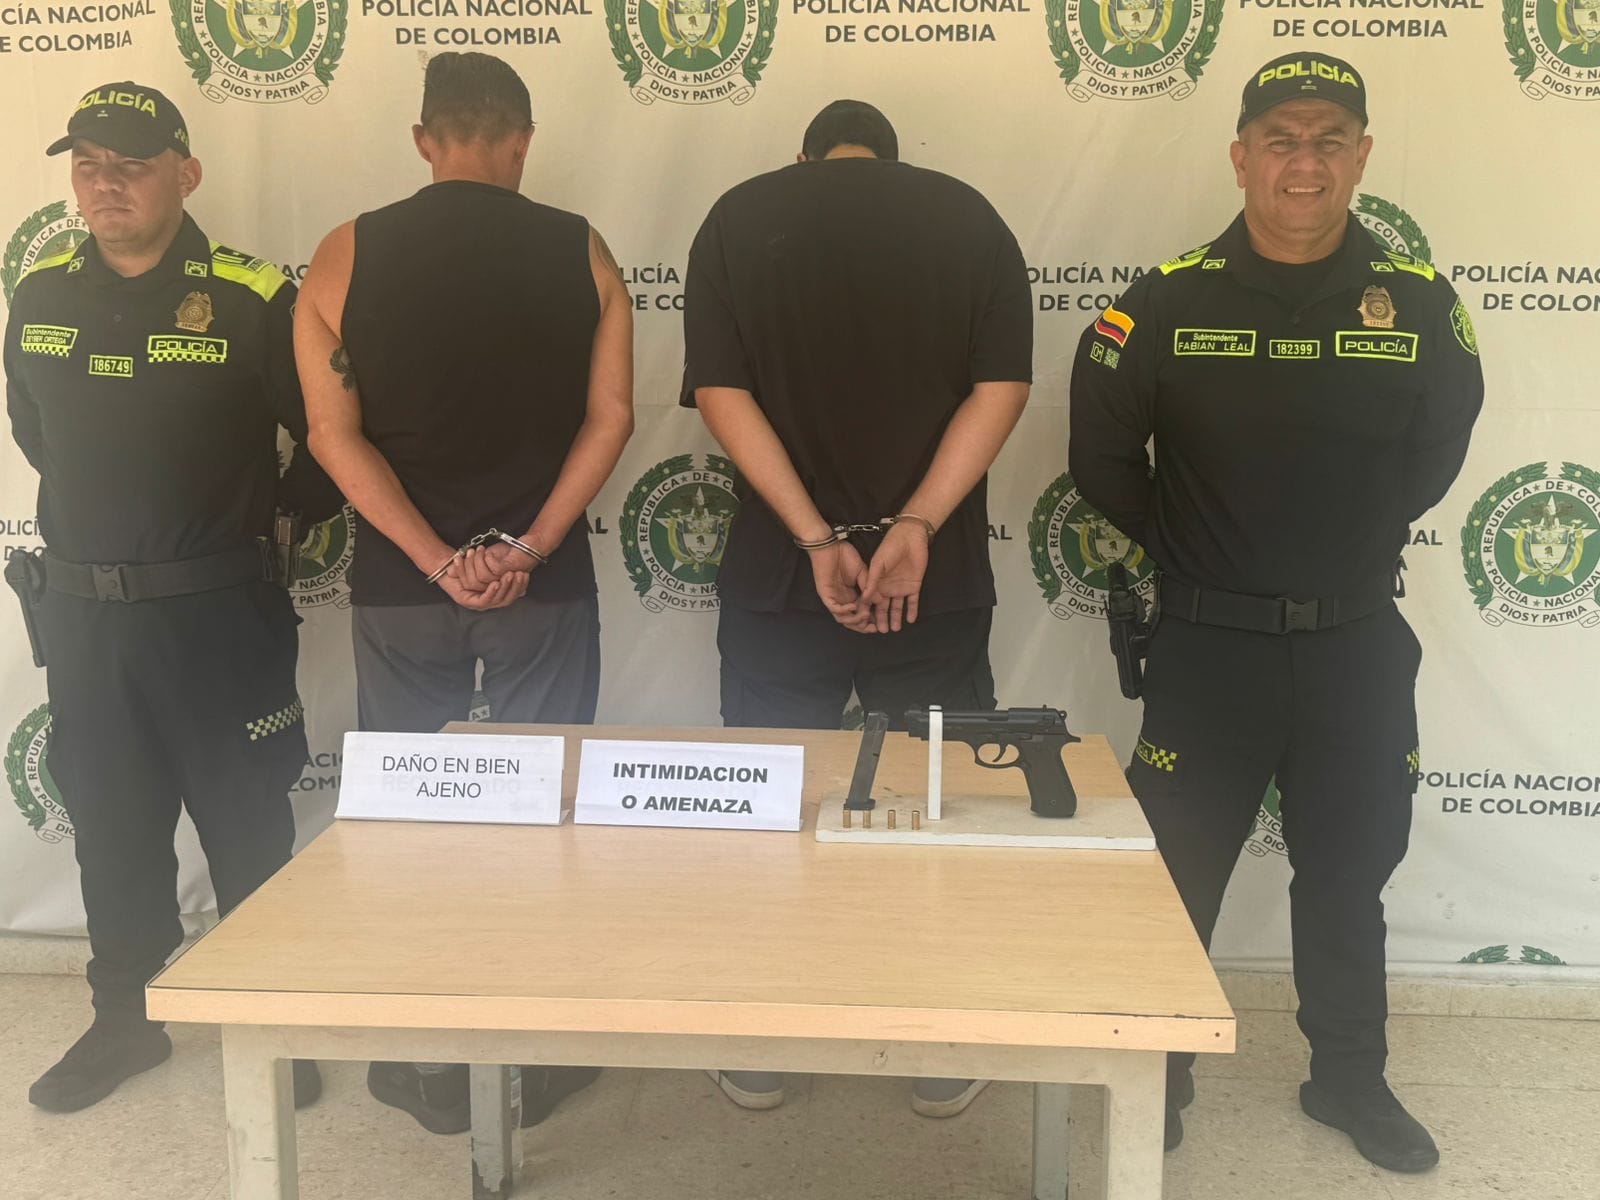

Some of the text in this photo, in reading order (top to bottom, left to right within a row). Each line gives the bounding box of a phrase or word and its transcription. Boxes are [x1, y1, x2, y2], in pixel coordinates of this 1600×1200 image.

[47, 0, 156, 24] NACIONAL
[466, 0, 593, 16] NACIONAL
[898, 0, 1030, 13] NACIONAL
[395, 26, 561, 45] DE COLOMBIA
[825, 24, 996, 43] DE COLOMBIA
[1273, 19, 1448, 37] DE COLOMBIA
[18, 30, 133, 52] COLOMBIA
[265, 40, 322, 83] NACIONAL
[693, 41, 751, 84] NACIONAL
[1133, 36, 1197, 80] NACIONAL
[266, 80, 310, 100] PATRIA
[693, 81, 737, 101] PATRIA
[1132, 75, 1178, 96] PATRIA
[22, 218, 81, 274] UBLICA DE
[1374, 222, 1407, 254] COLO
[618, 262, 680, 284] LICÍA
[1026, 262, 1104, 284] OLICÍA
[1451, 261, 1549, 284] POLICÍA
[1039, 294, 1070, 311] DE
[1483, 293, 1514, 311] DE
[155, 340, 218, 354] POLICÍA
[1178, 341, 1251, 352] FABIAN LEAL
[1276, 343, 1313, 355] 182399
[1344, 338, 1409, 354] POLICÍA
[94, 359, 130, 373] 186749
[693, 472, 710, 482] DE
[1546, 480, 1564, 491] DE
[300, 553, 352, 590] NACIONAL
[300, 587, 340, 605] PATRIA
[700, 599, 719, 608] PAT
[1542, 605, 1587, 623] PATRIA
[382, 753, 521, 775] DAÑO EN BIEN
[613, 762, 769, 784] INTIMIDACION
[416, 781, 482, 799] AJENO
[38, 793, 70, 820] POLIC
[621, 794, 753, 814] O AMENAZA
[1442, 797, 1473, 814] DE
[55, 822, 76, 838] DIO
[1257, 809, 1282, 834] OLIC
[1263, 835, 1289, 852] DIO
